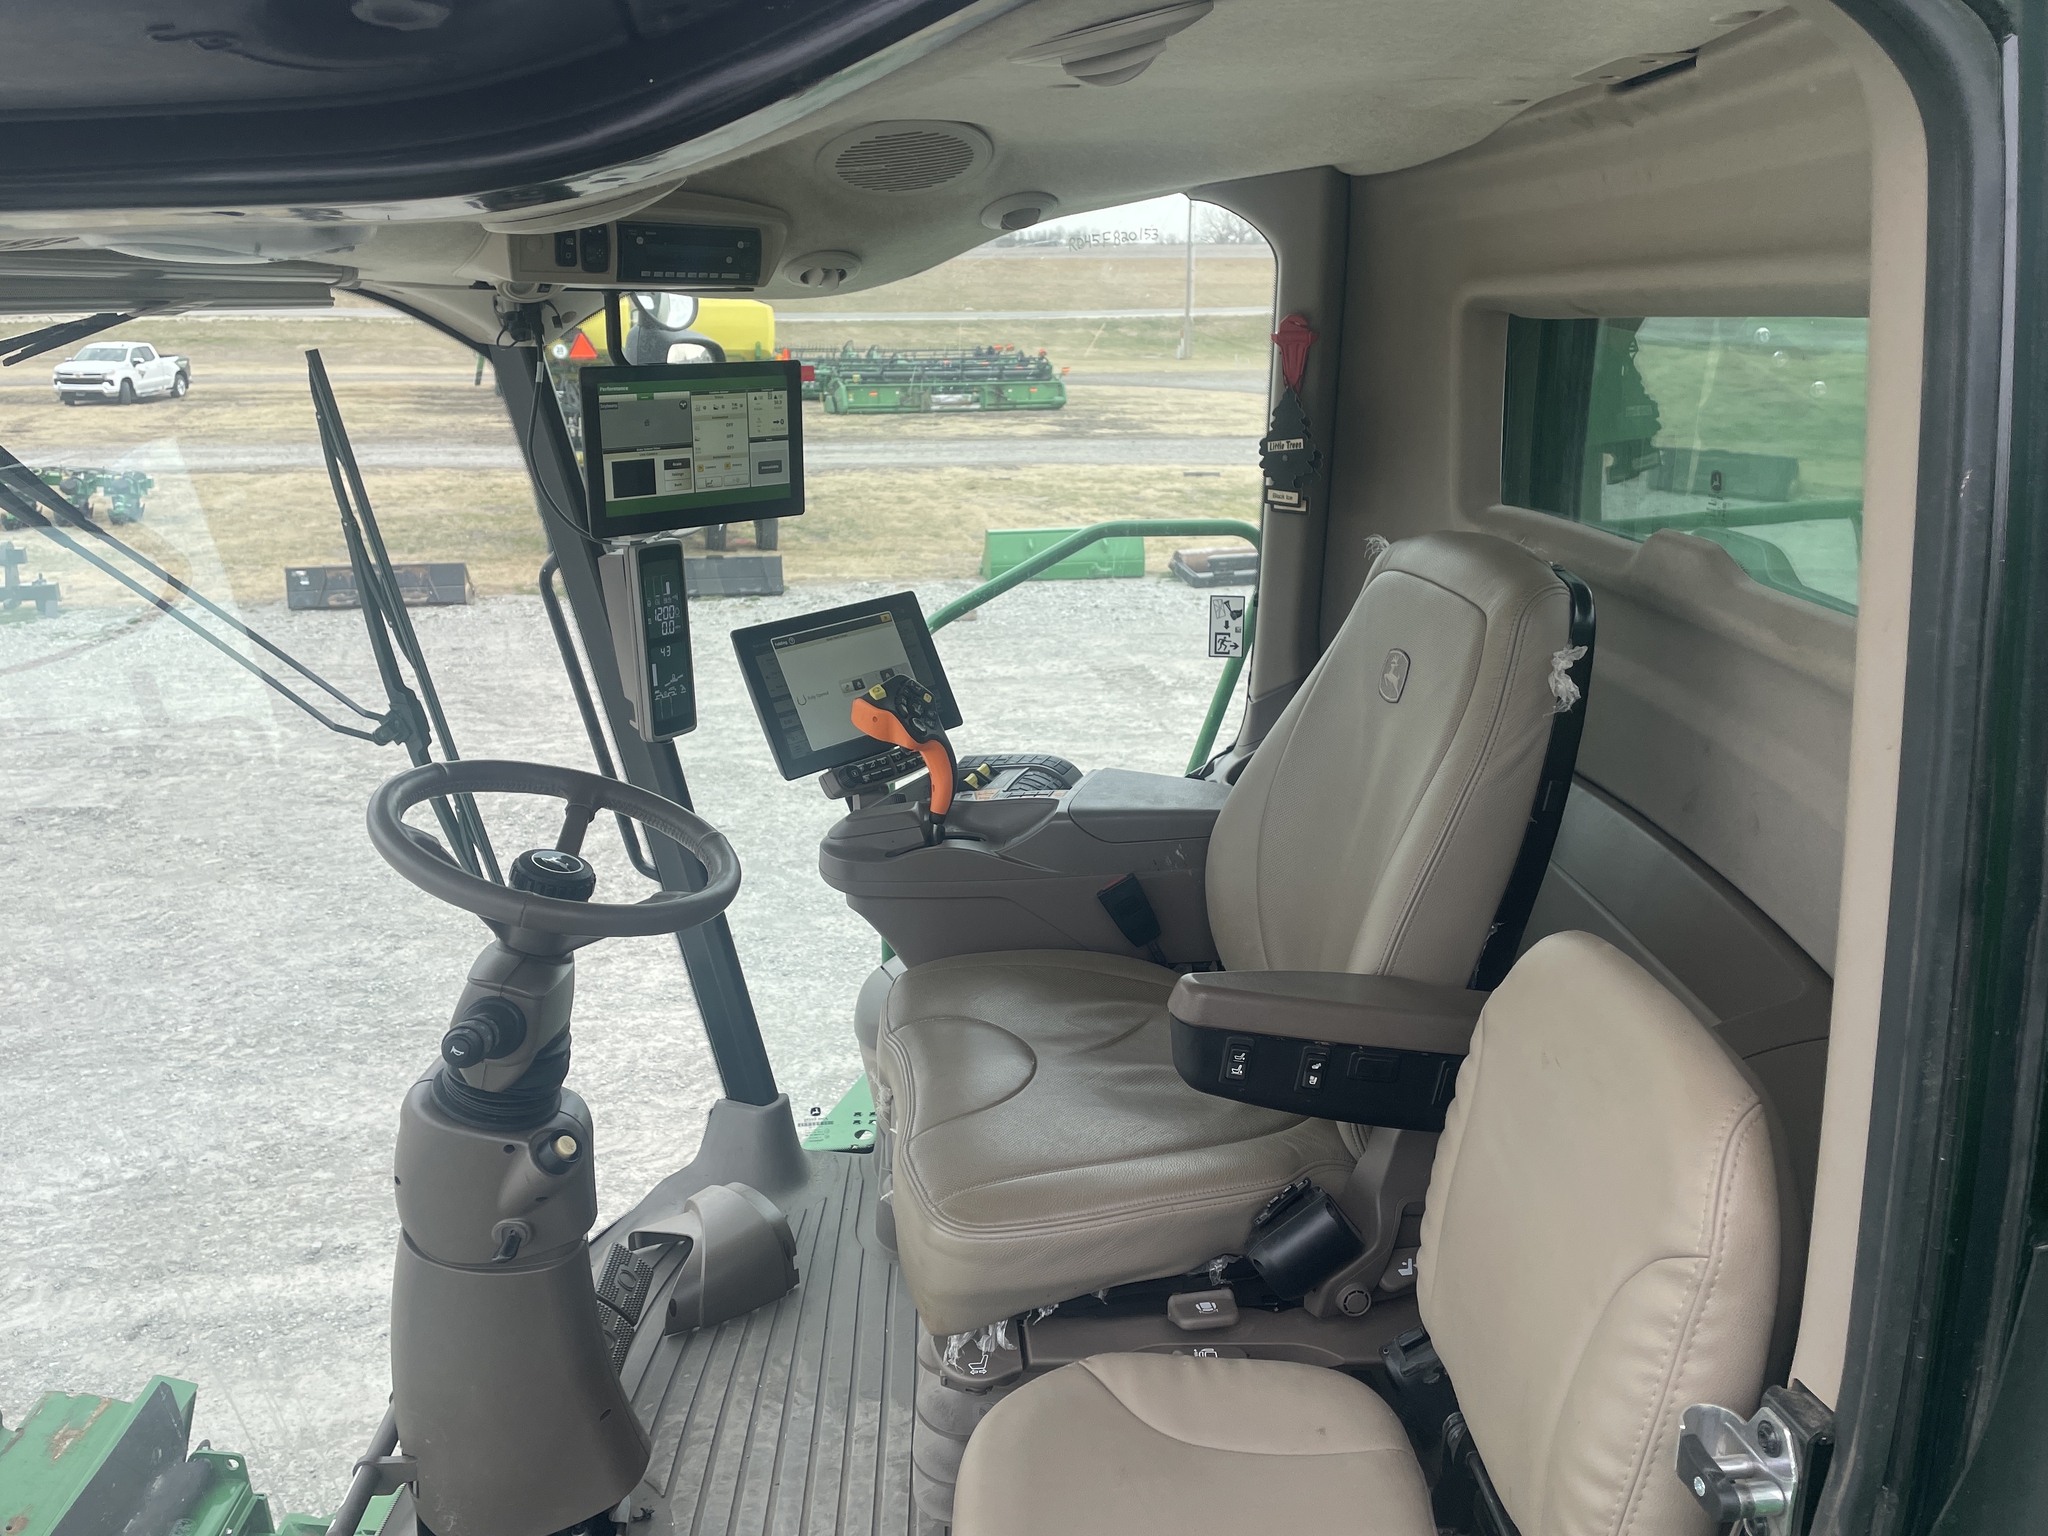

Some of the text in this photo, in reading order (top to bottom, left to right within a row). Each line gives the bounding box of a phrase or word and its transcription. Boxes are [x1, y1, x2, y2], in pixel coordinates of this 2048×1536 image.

[1269, 440, 1302, 451] Little Trees
[654, 604, 675, 622] 1200
[661, 620, 675, 636] 0.0
[660, 645, 671, 657] 43
